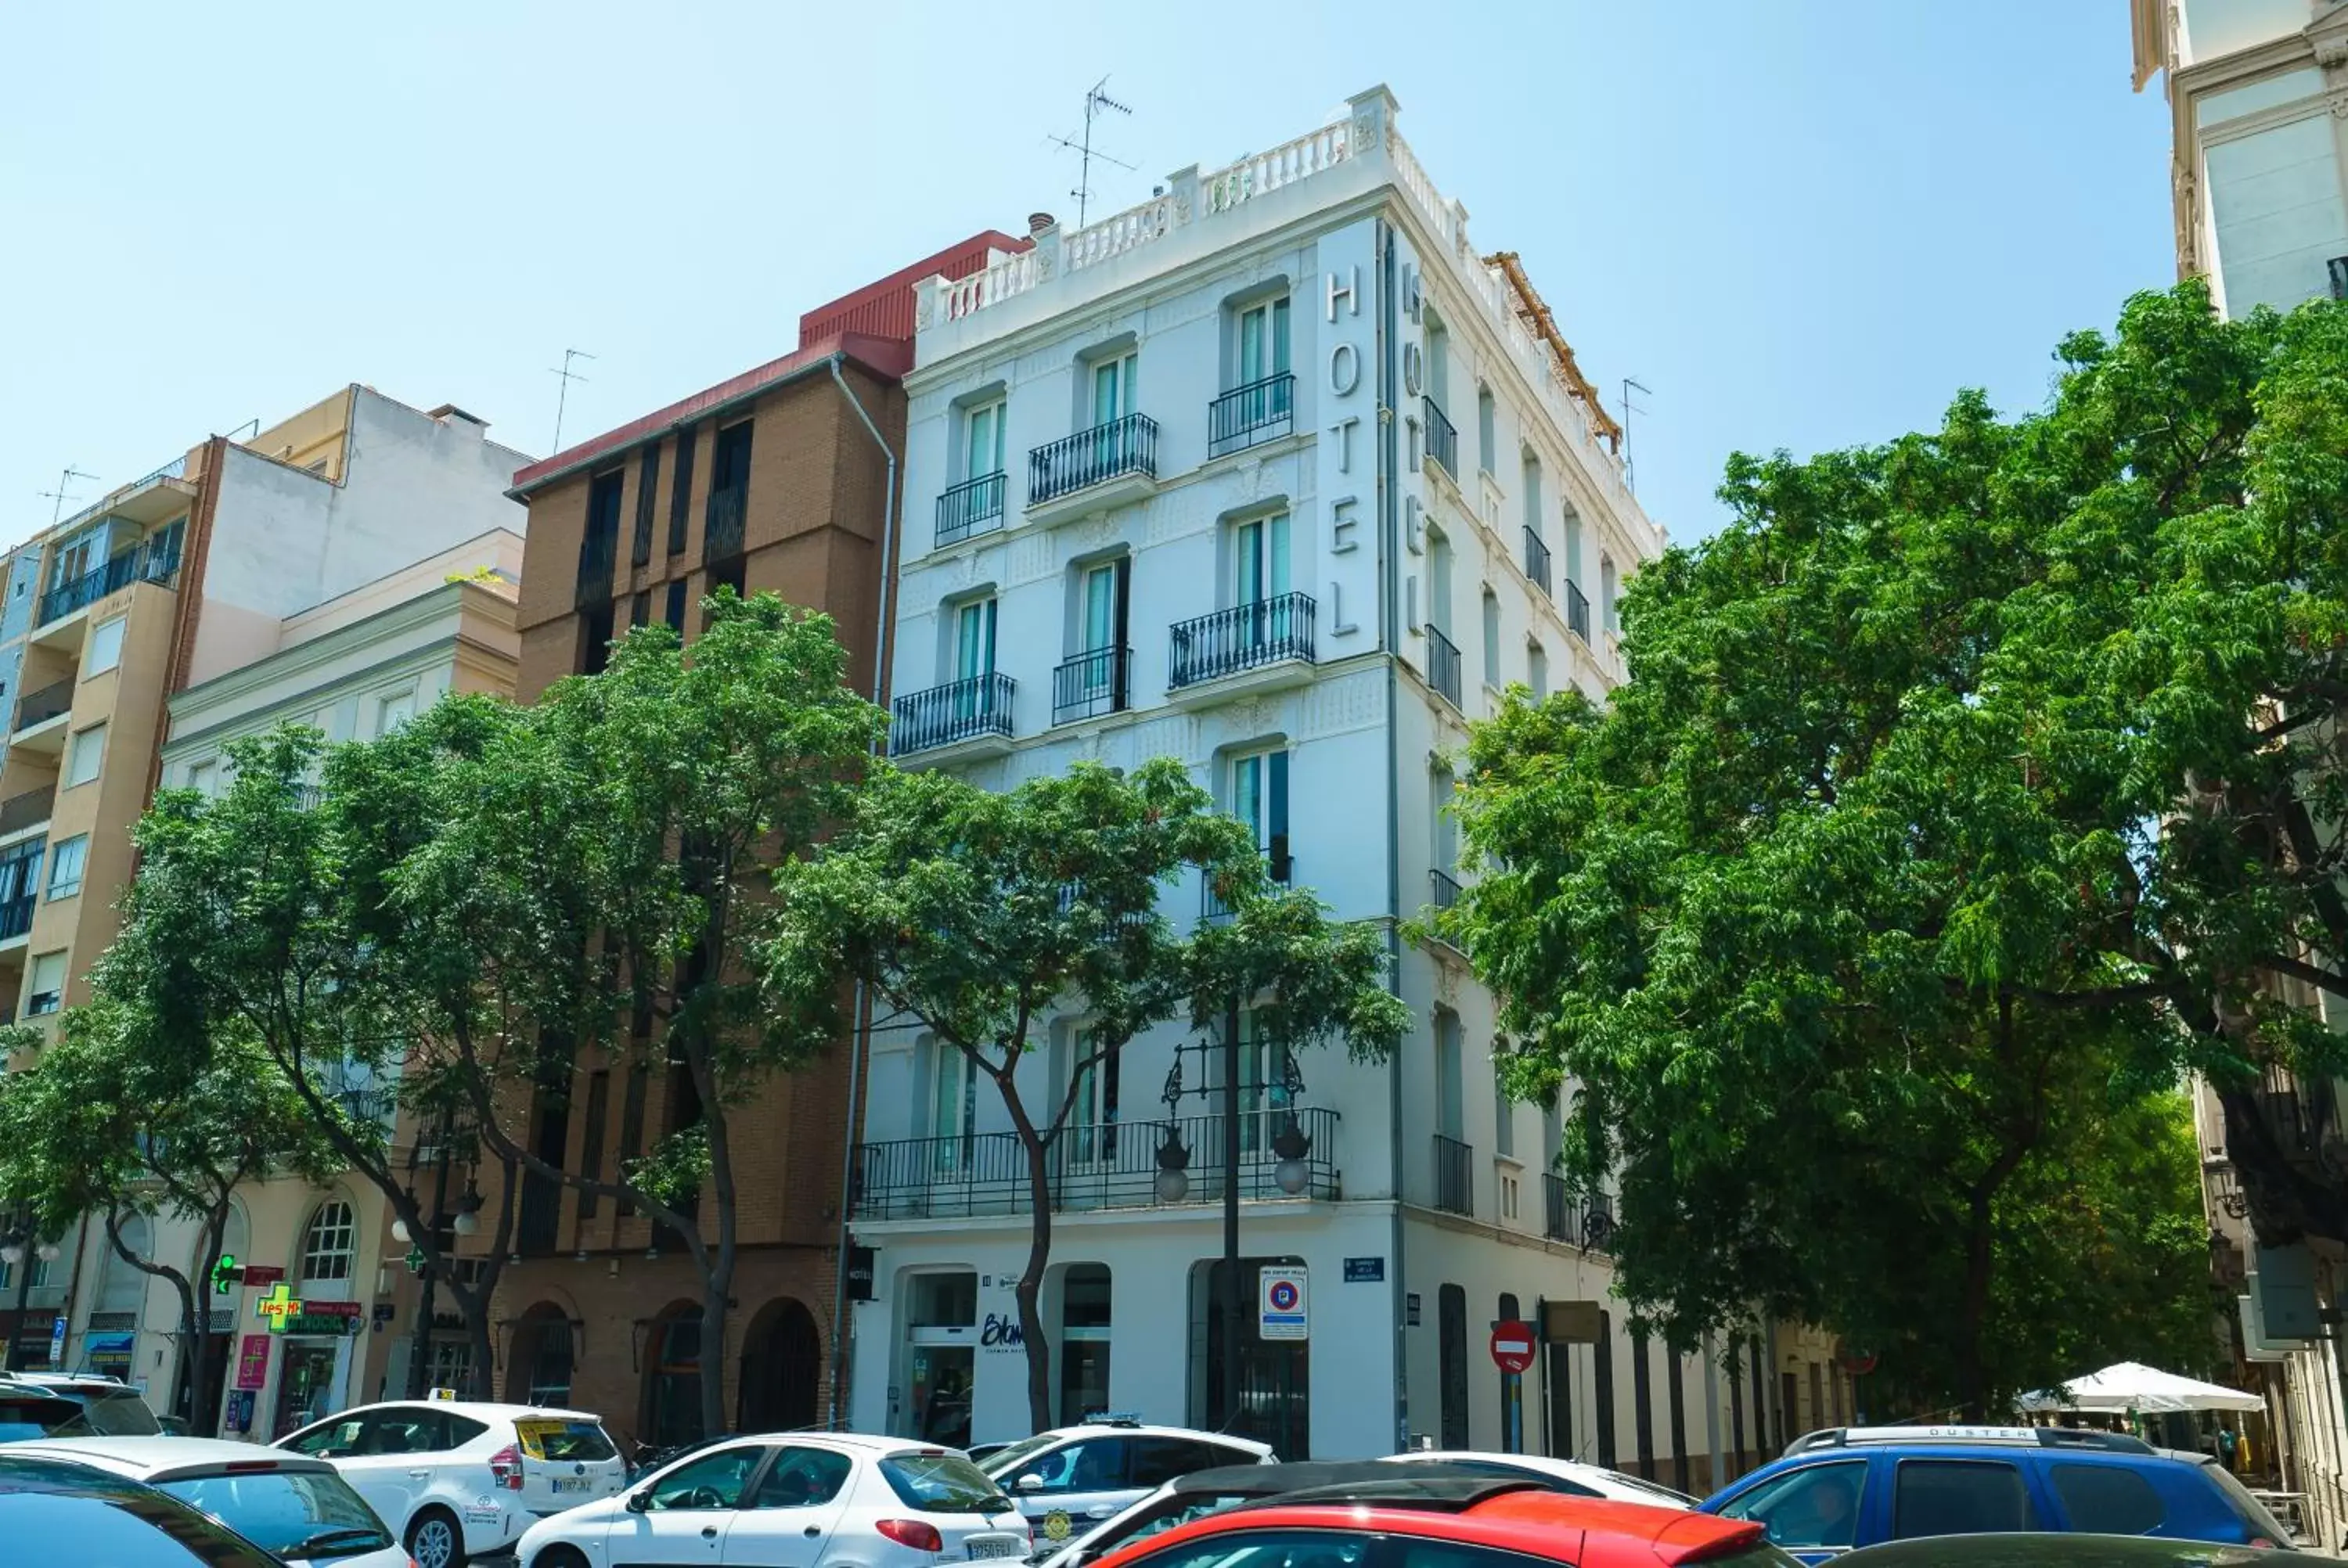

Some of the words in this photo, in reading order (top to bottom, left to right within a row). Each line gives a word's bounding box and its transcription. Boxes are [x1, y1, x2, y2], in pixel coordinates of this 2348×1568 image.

[1327, 264, 1359, 638] HOTEL
[1403, 262, 1425, 637] HOTEL
[849, 1269, 873, 1279] HOTEL
[1928, 1428, 2027, 1437] DUSTER
